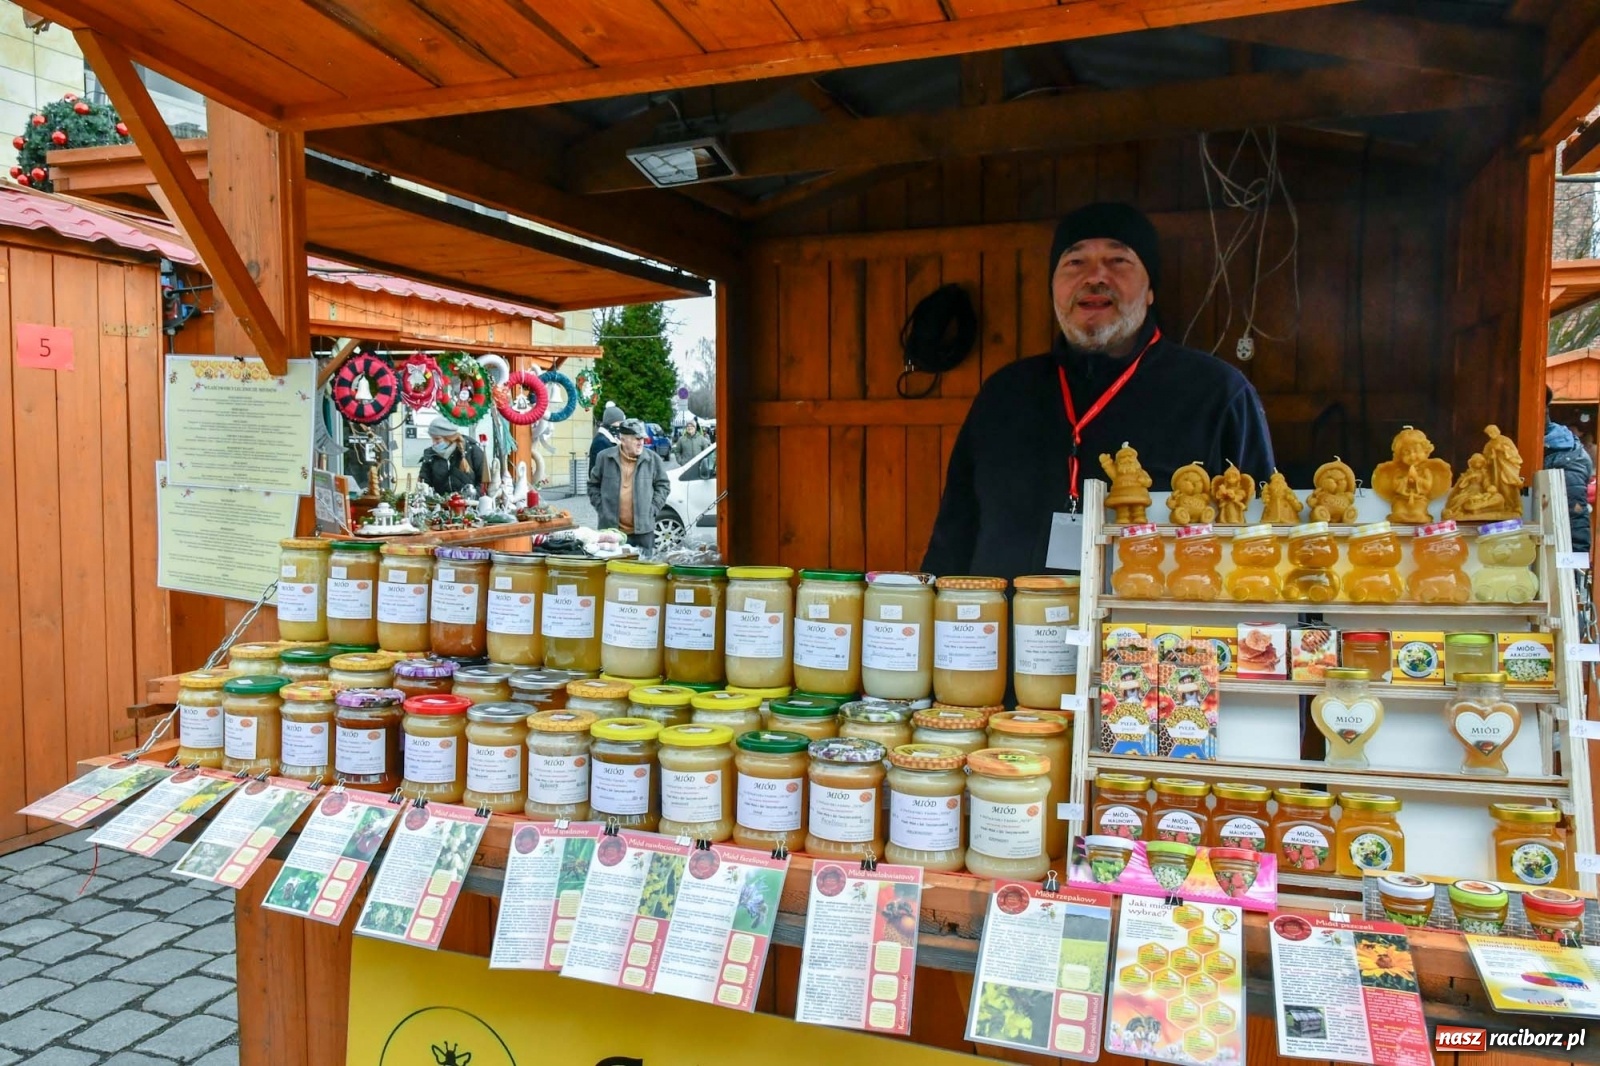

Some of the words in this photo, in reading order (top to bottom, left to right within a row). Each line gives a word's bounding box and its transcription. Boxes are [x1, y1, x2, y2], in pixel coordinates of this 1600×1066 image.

[40, 338, 51, 357] 5
[619, 606, 638, 614] MIÓD
[741, 613, 760, 622] MIÓD
[806, 625, 826, 633] MIÓD
[953, 624, 974, 632] MIÓD
[1035, 628, 1058, 636] MIÓD
[1336, 716, 1363, 724] MIÓD
[1471, 727, 1500, 735] MIÓD
[412, 739, 430, 747] MIÓD
[543, 758, 565, 767] MIÓD
[603, 767, 625, 775] MIÓD
[674, 774, 696, 782] MIÓD
[754, 782, 777, 791] MIÓD
[826, 791, 850, 800] MIÓD
[911, 798, 937, 807] MIÓD
[991, 806, 1017, 815] MIÓD
[1296, 830, 1315, 838] MIÓD
[628, 838, 645, 847] Miód
[722, 851, 737, 861] Miód
[847, 868, 865, 877] Miód
[866, 870, 916, 882] wielokwiatowy
[1034, 889, 1055, 899] Miód
[1056, 894, 1097, 905] rzepakowy
[1128, 899, 1147, 908] Jaki
[1149, 902, 1173, 911] miód
[1127, 907, 1168, 918] wybrać?
